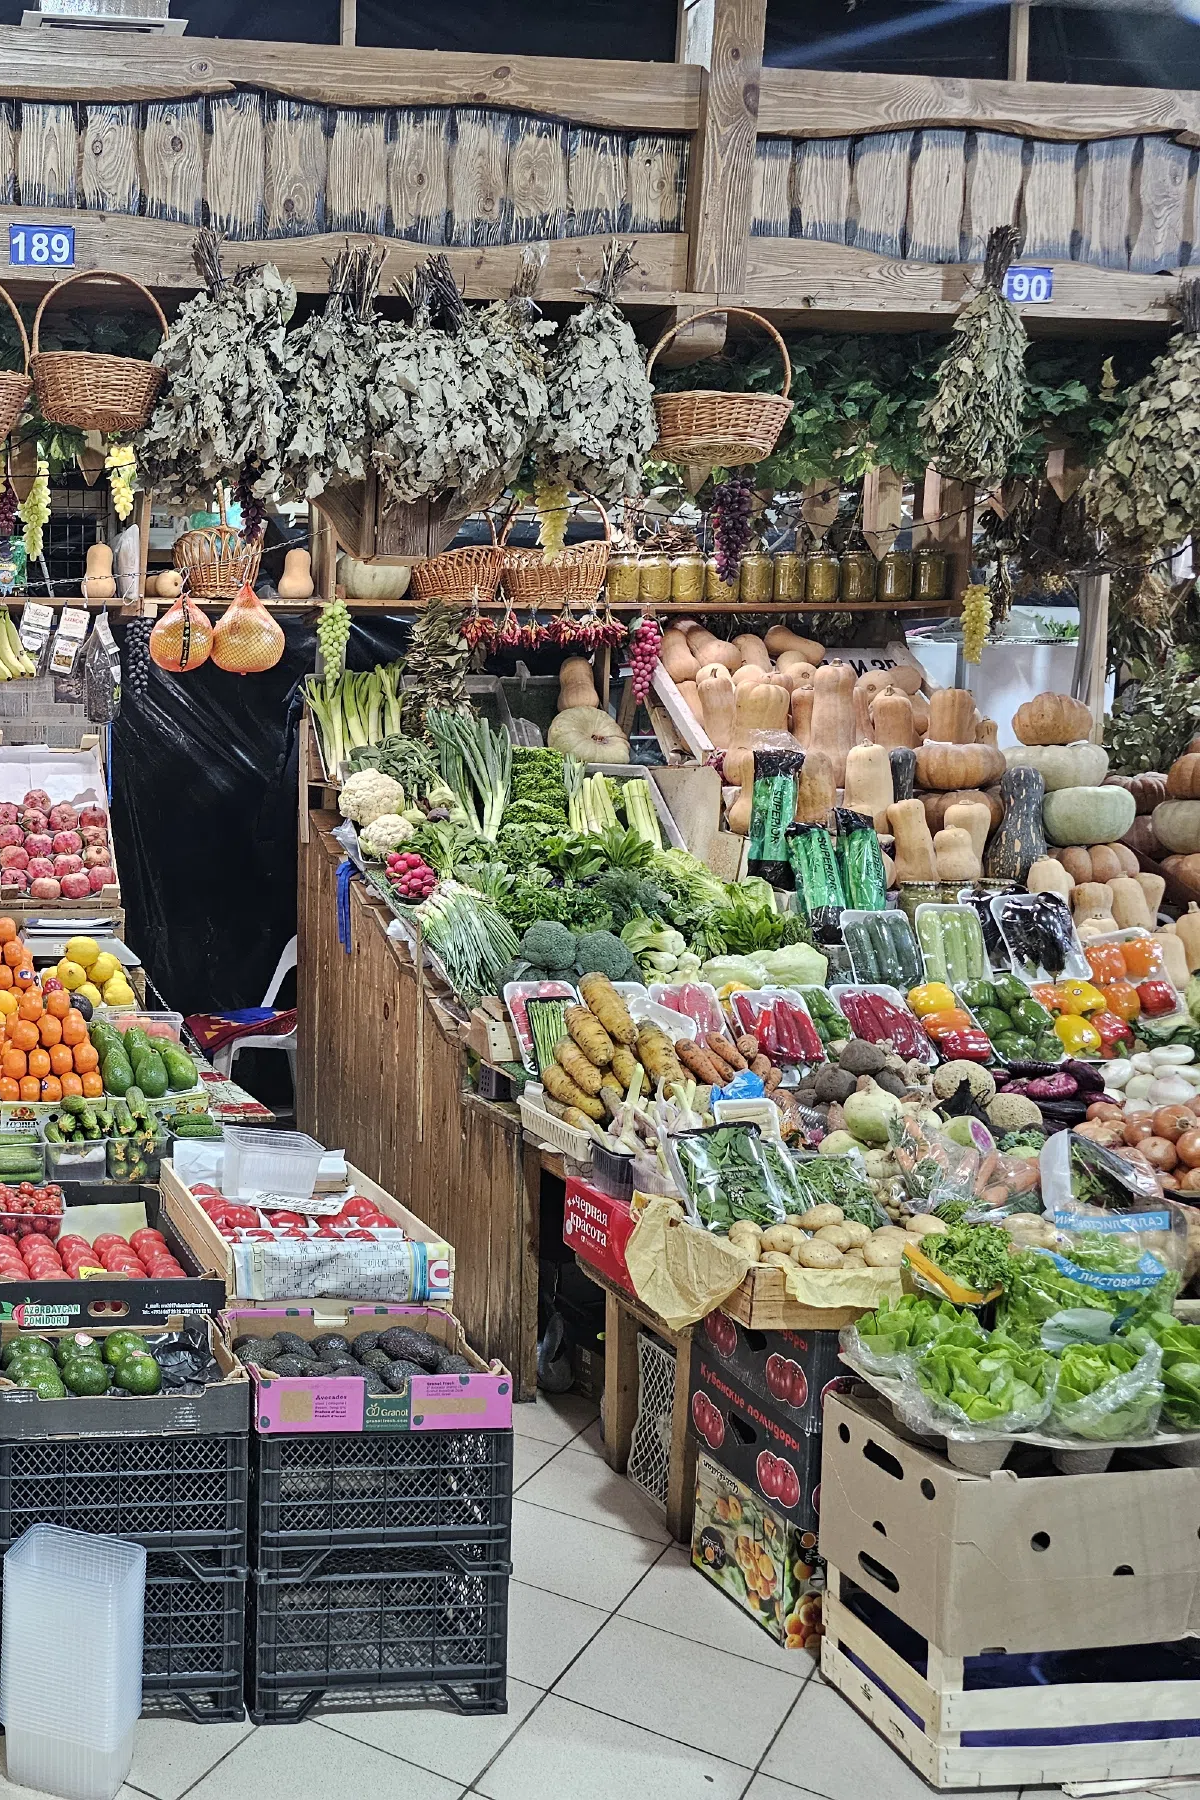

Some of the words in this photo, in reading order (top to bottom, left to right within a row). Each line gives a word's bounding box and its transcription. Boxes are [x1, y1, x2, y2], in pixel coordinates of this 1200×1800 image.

[12, 231, 70, 263] 189
[770, 790, 782, 844] SUPERIOR
[817, 836, 837, 890] SUPERIOR
[574, 1194, 608, 1227] черная
[570, 1211, 607, 1248] красота
[1078, 1273, 1141, 1287] ЛИСТОВОЙ
[24, 1304, 79, 1315] AZƏRBAYCAN
[24, 1315, 69, 1326] POMİDORU
[380, 1408, 409, 1417] Granot
[700, 1361, 745, 1408] Кубанские
[747, 1403, 800, 1452] помидоры
[702, 1459, 739, 1495] Uzbekistan
